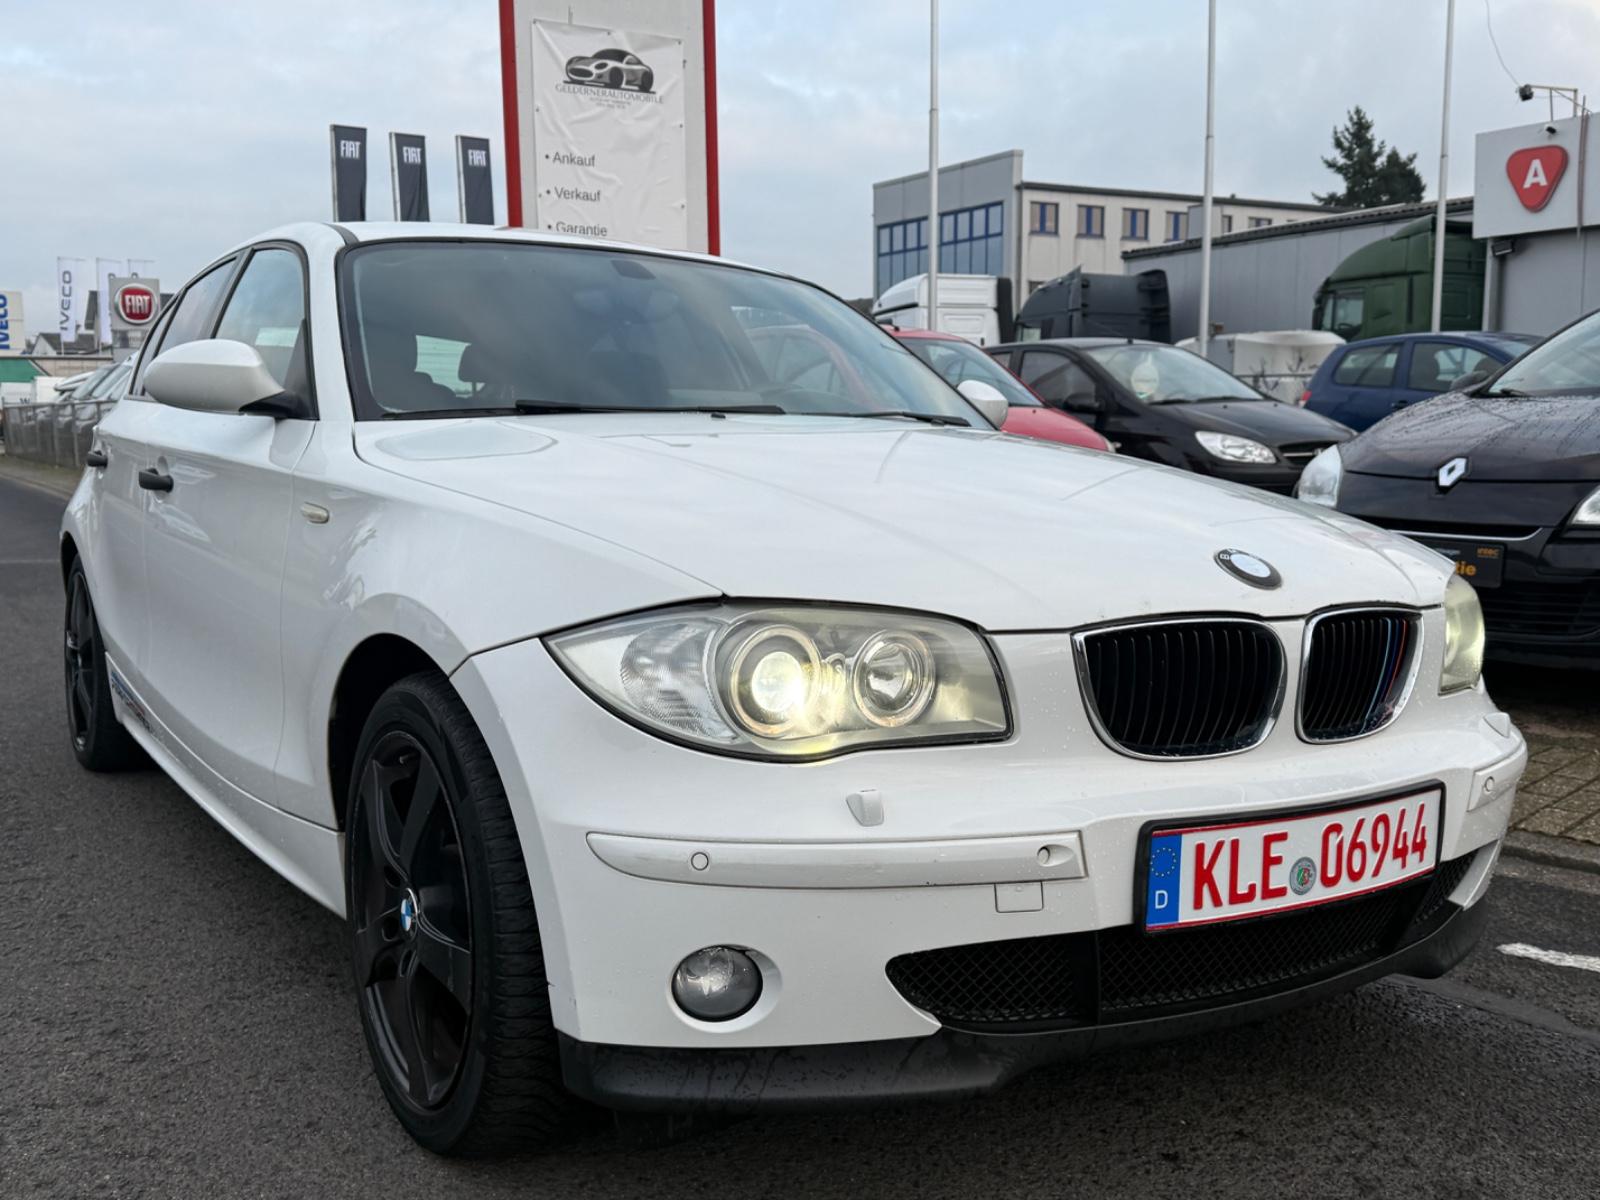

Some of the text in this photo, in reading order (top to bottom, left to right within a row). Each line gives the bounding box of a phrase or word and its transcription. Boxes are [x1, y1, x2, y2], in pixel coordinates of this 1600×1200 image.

[340, 140, 361, 159] FIAT
[402, 146, 422, 164] FIAT
[468, 149, 487, 167] FIAT
[553, 151, 596, 168] Ankauf
[1523, 158, 1548, 189] A
[554, 186, 602, 202] Verkauf
[556, 220, 608, 237] Garantie
[60, 270, 72, 331] IVECO
[124, 293, 151, 315] FIAT
[1193, 803, 1427, 911] KLE 06944
[1154, 889, 1169, 910] D
